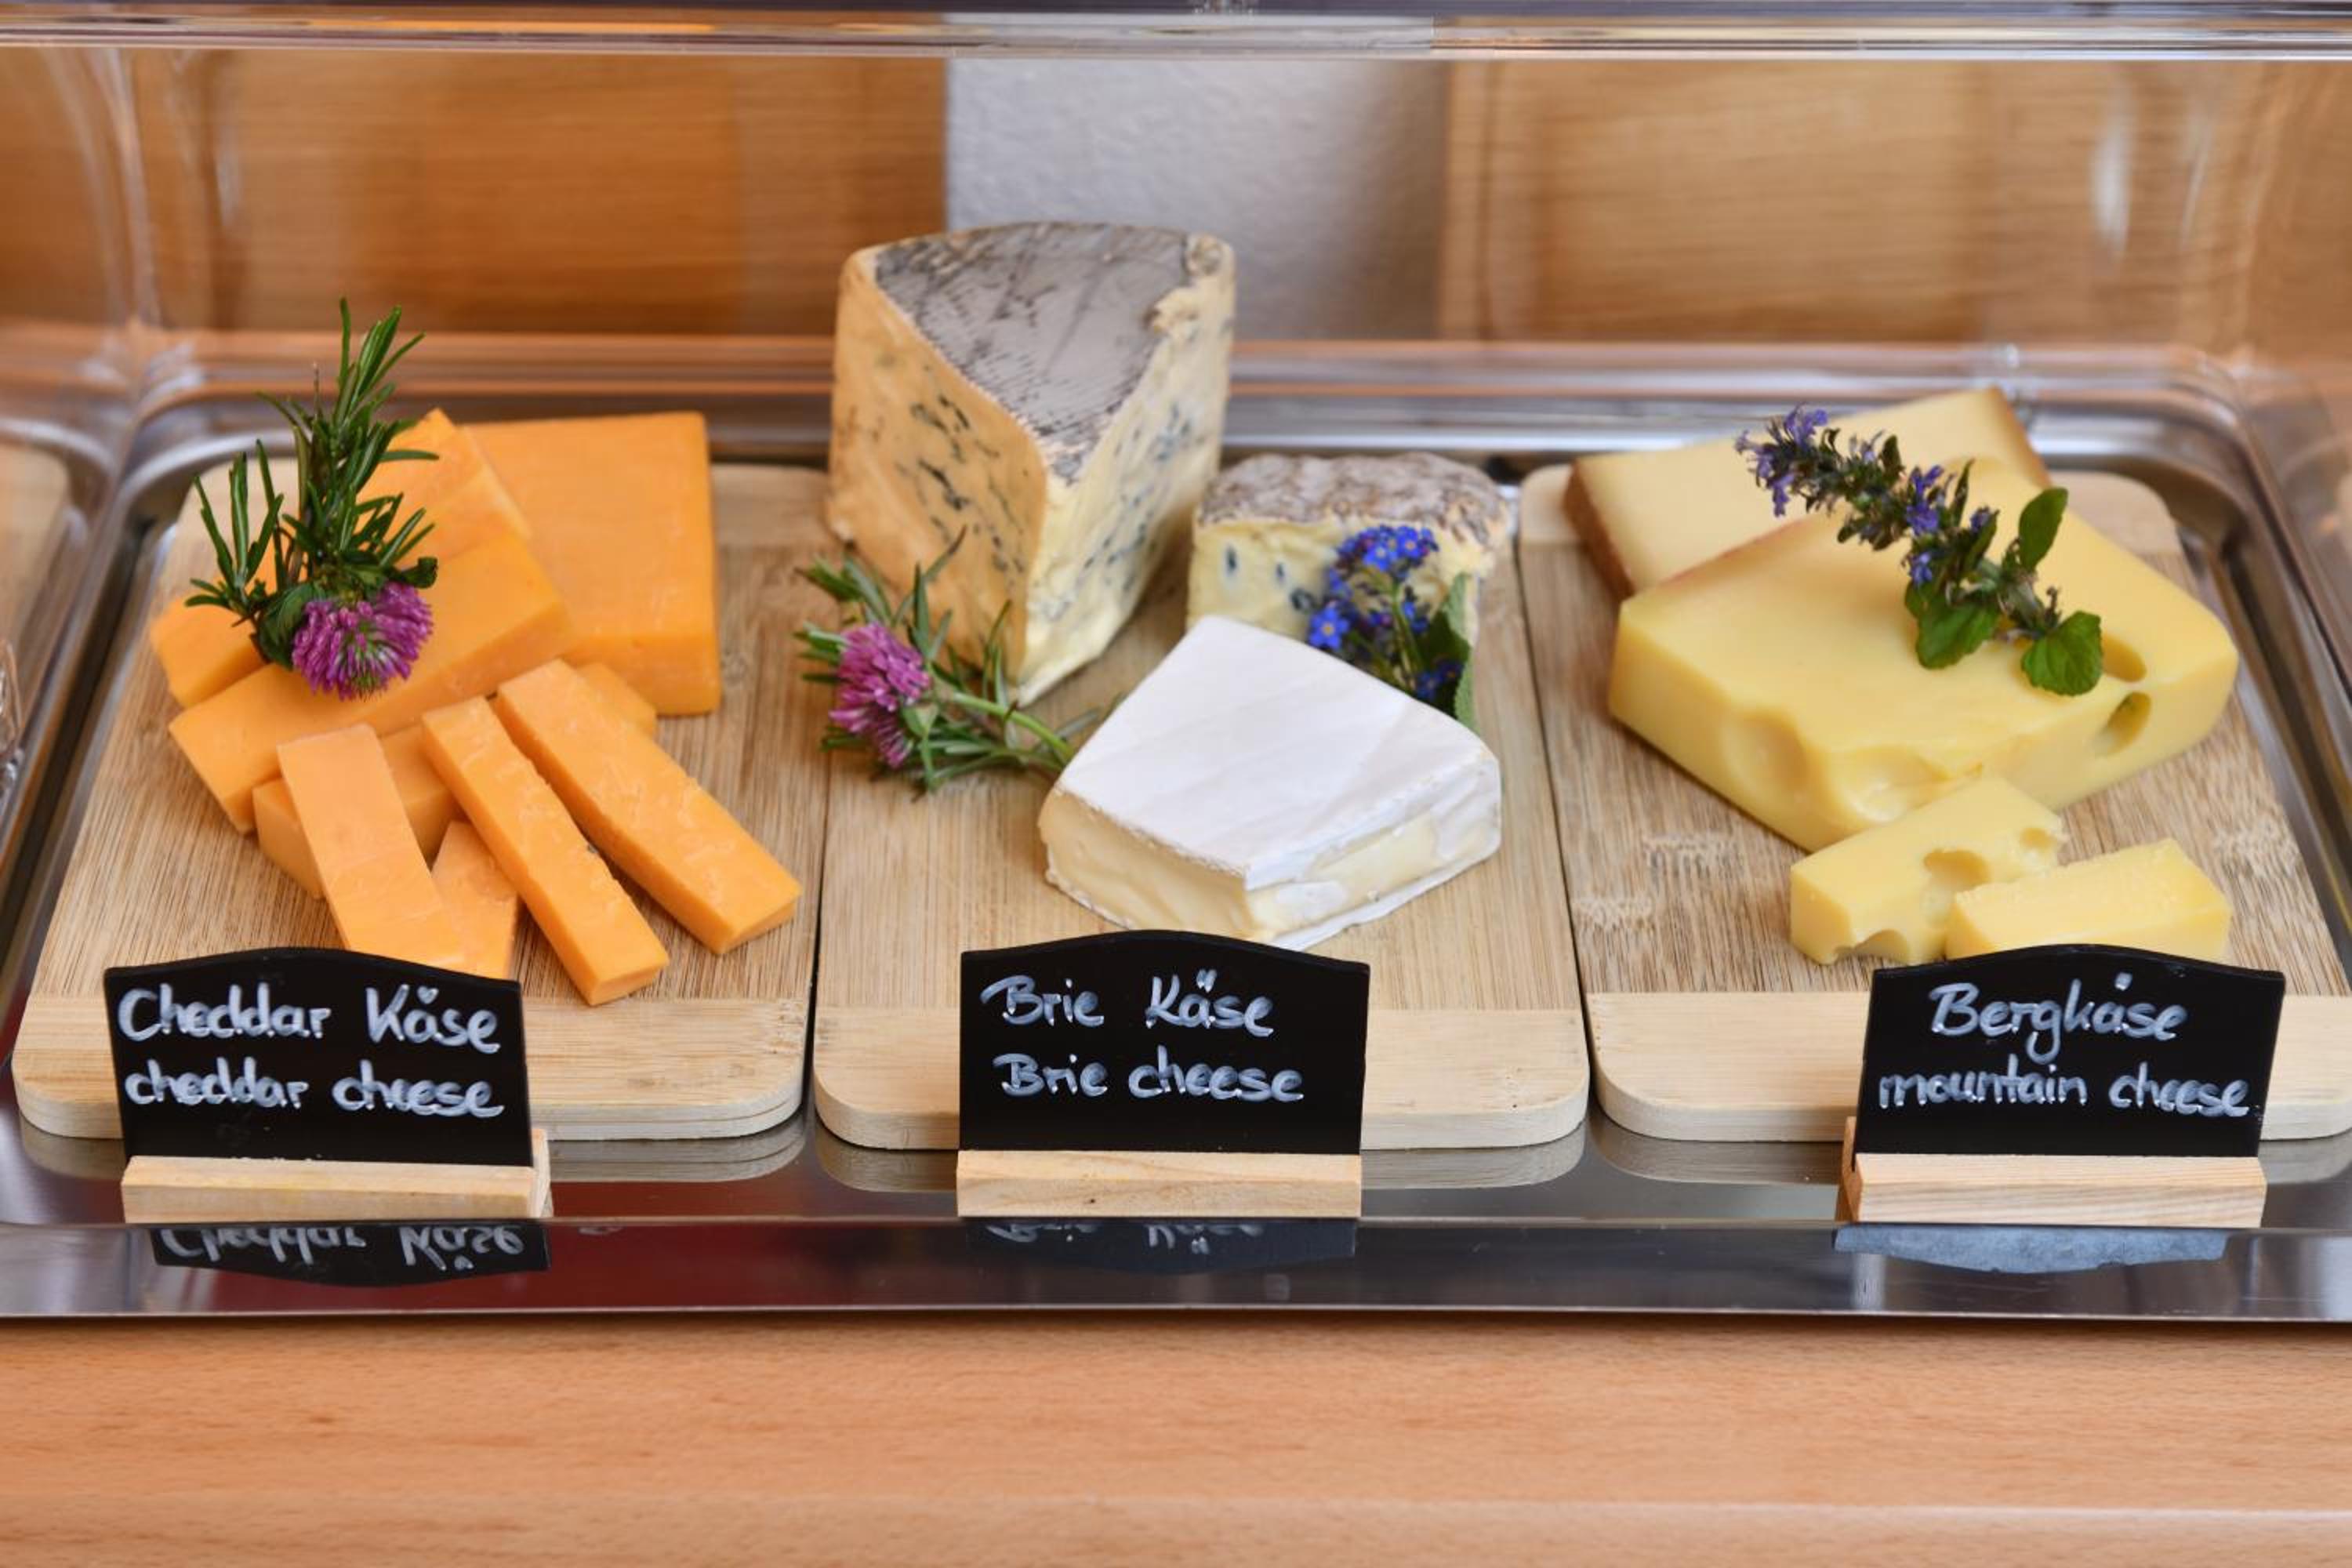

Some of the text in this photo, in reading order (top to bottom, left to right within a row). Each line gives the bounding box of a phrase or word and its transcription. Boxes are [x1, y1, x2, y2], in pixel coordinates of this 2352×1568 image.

[119, 982, 500, 1054] Cheddar Käse
[980, 969, 1274, 1036] Brie Käse
[1928, 973, 2188, 1063] Bergkäse
[124, 1056, 504, 1117] cheddar cheese
[993, 1045, 1304, 1102] Brie cheese
[1878, 1054, 2249, 1117] mountain cheese
